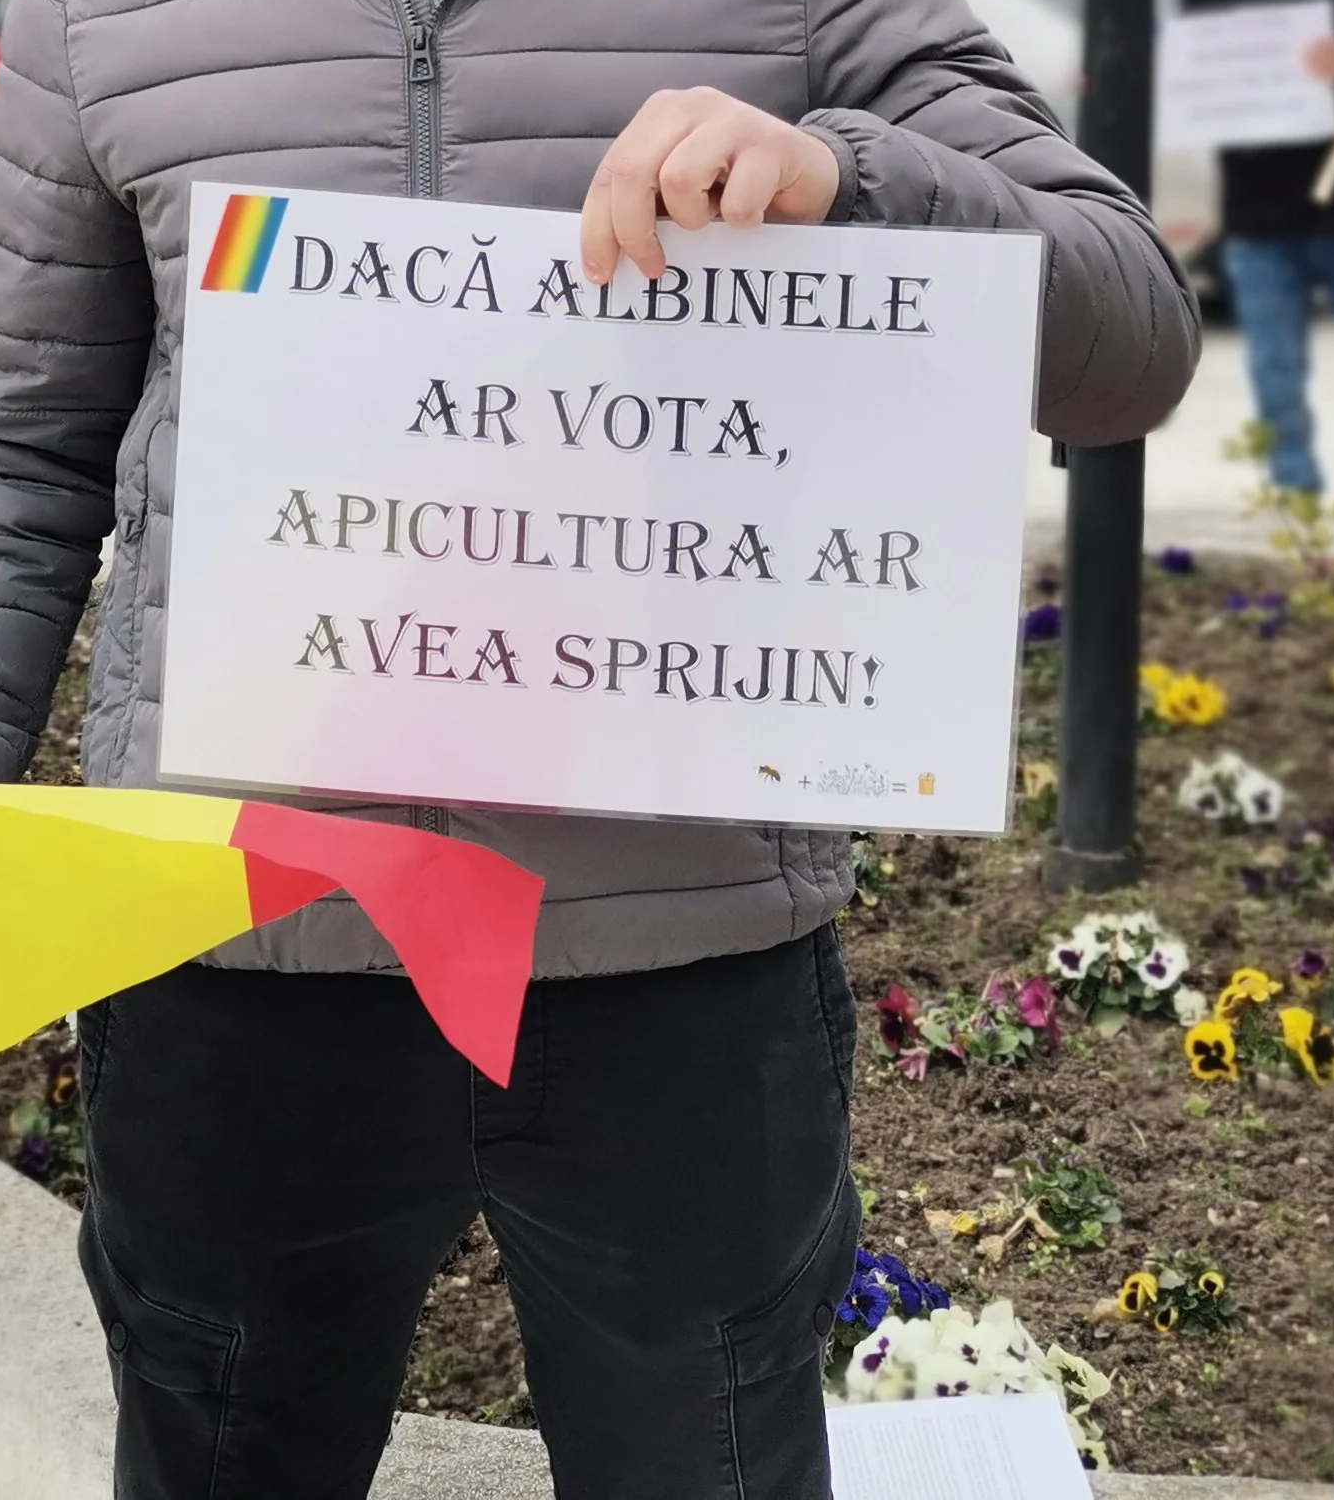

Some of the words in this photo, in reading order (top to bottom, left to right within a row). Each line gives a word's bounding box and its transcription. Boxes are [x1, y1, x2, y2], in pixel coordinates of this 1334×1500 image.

[288, 232, 505, 315] DACĂ
[525, 257, 936, 338] ALBINELE
[405, 377, 523, 449] AR
[547, 380, 793, 471] VOTA,
[266, 487, 782, 585] APICULTURA
[805, 526, 926, 595] AR
[293, 610, 525, 688] AVEA
[549, 632, 886, 709] SPRIJIN!
